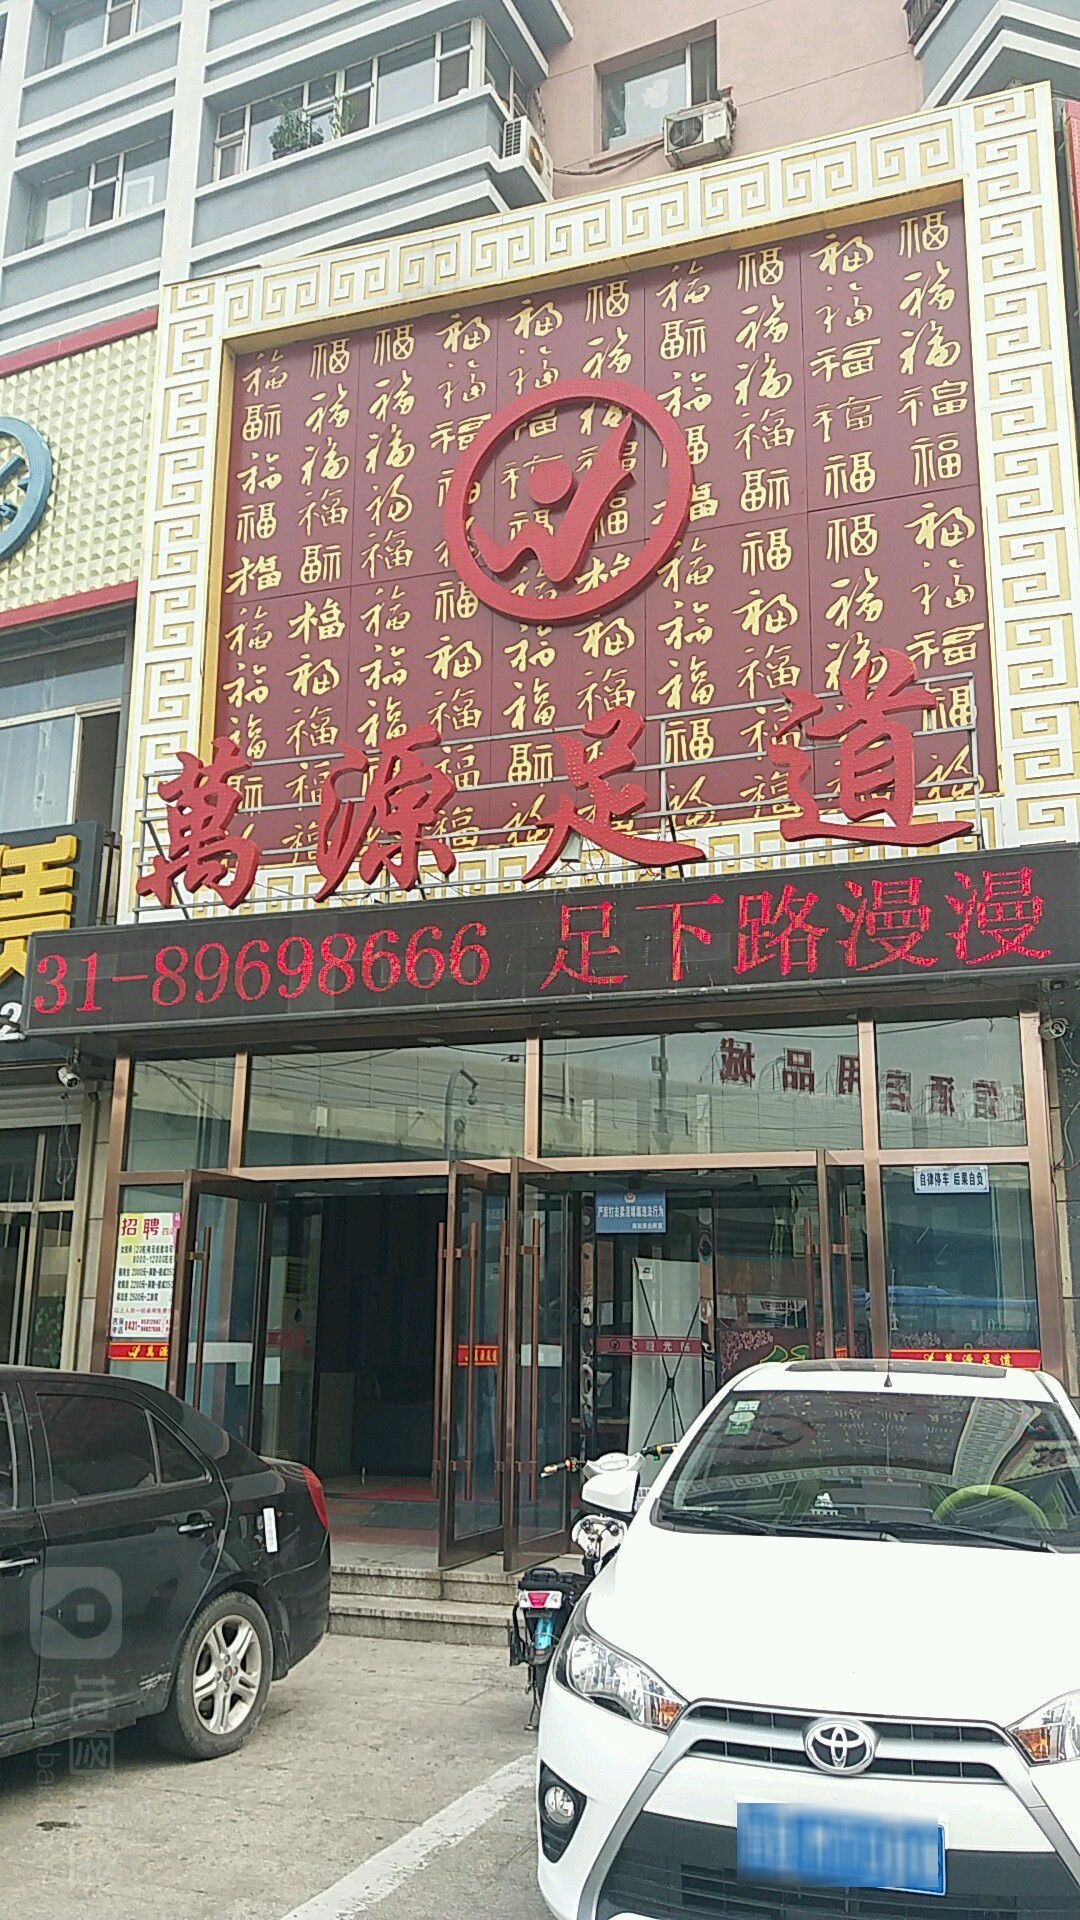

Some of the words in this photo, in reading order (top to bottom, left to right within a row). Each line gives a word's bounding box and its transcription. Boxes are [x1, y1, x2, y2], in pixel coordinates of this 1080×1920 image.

[137, 648, 975, 909] 萬源足道
[540, 866, 1053, 991] 足下路漫漫
[920, 1172, 949, 1186] 自律停车
[953, 1172, 983, 1186] 后果自负
[121, 1218, 160, 1240] 招聘
